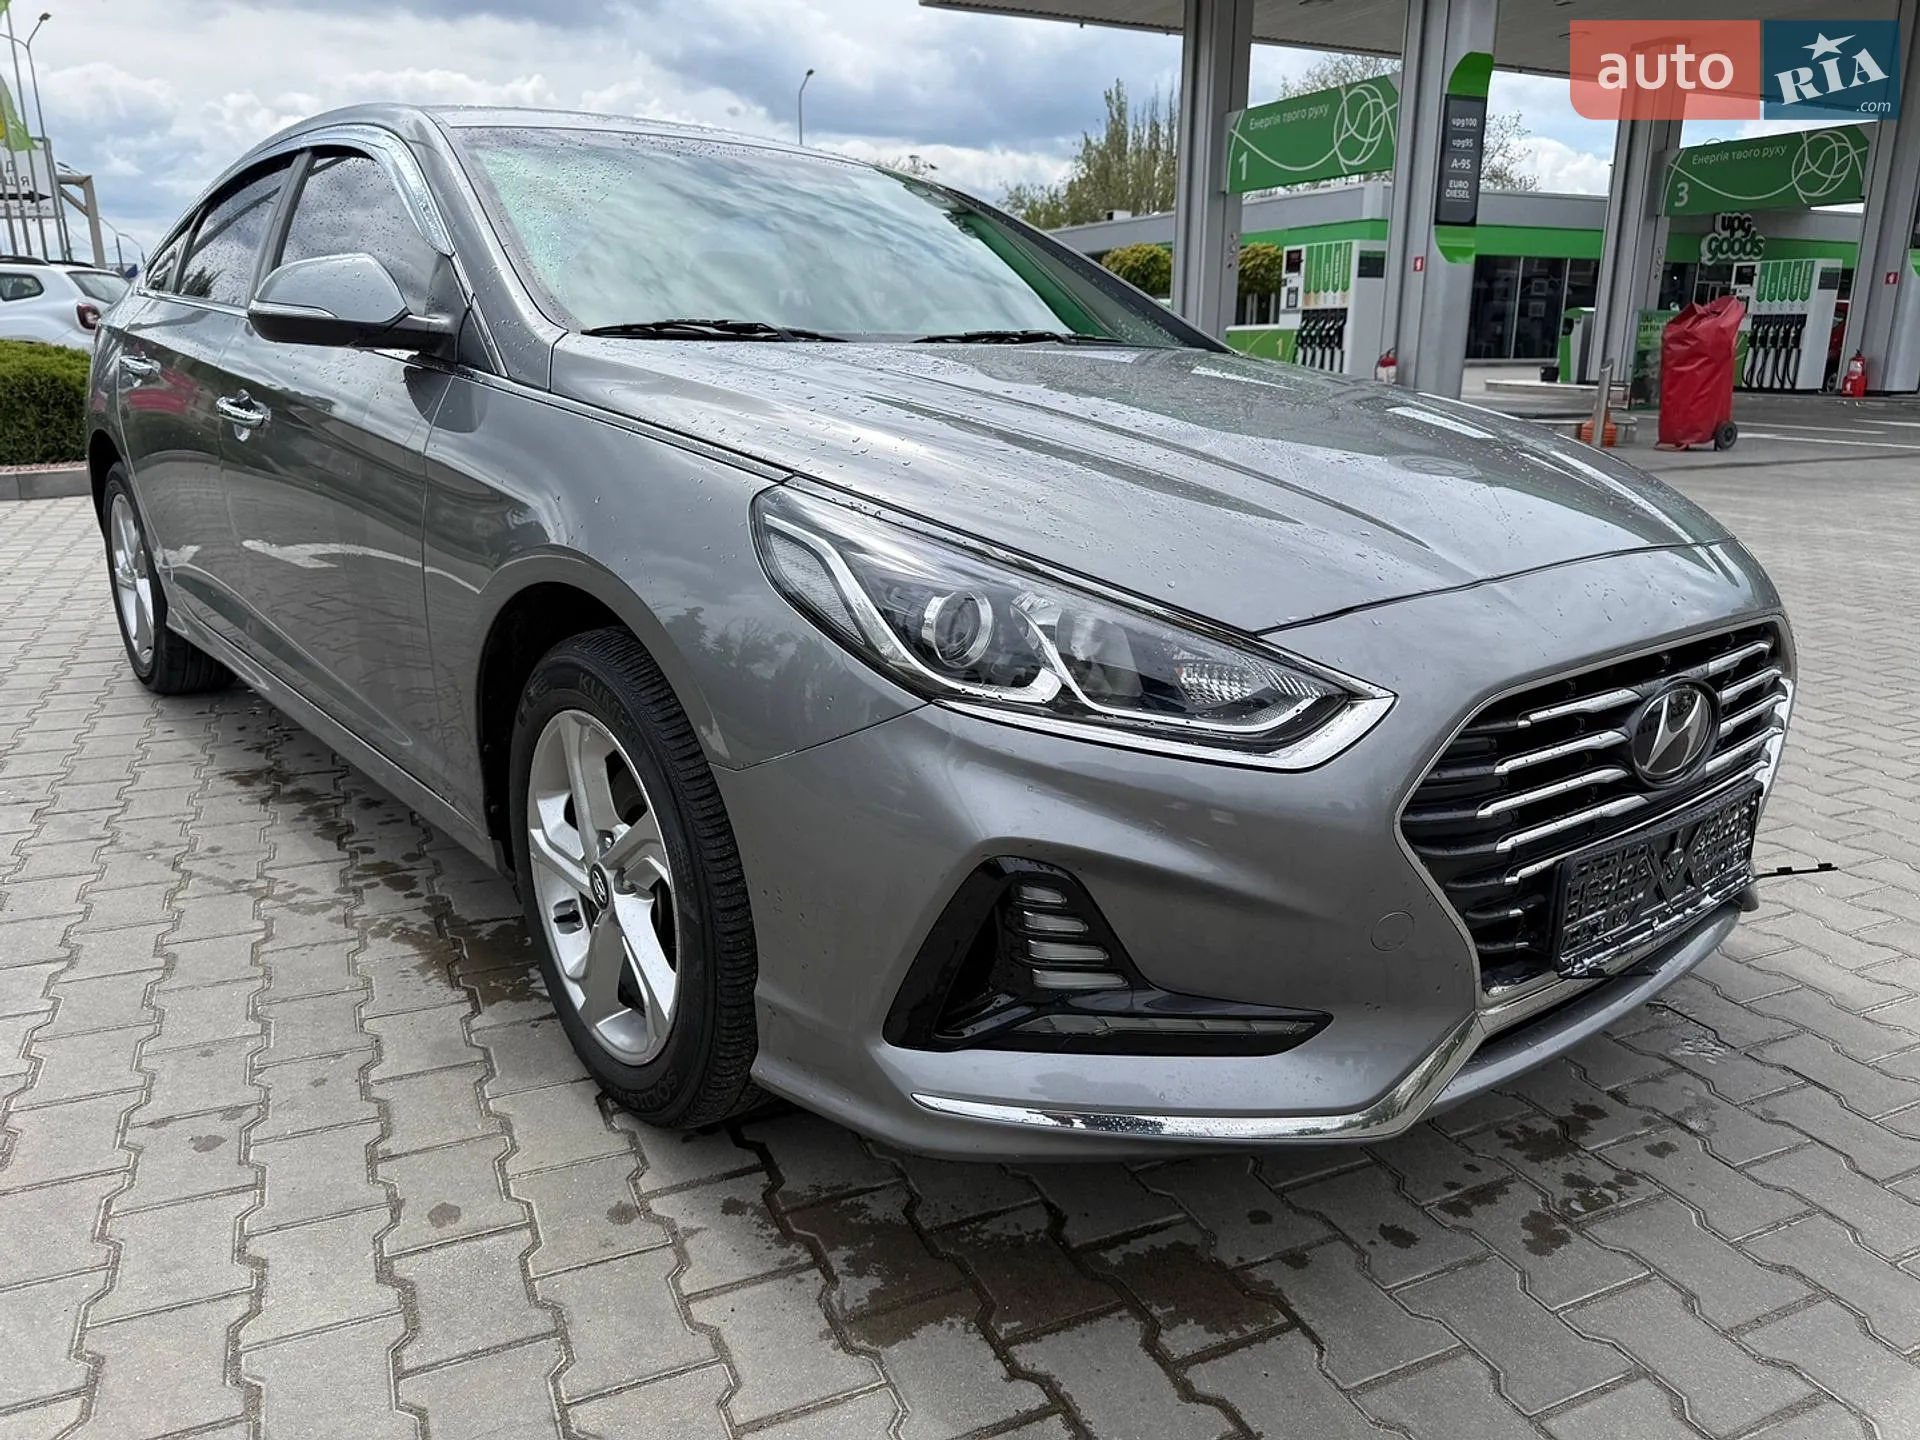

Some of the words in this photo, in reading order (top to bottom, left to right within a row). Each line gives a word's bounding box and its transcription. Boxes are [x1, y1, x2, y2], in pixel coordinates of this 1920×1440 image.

[1283, 109, 1307, 123] твого
[1307, 104, 1330, 120] руху
[1731, 148, 1760, 160] твого
[1761, 144, 1788, 158] руху
[1238, 151, 1248, 181] 1
[1445, 189, 1470, 199] DIESEL
[1448, 180, 1469, 189] EURO
[1674, 181, 1690, 207] 3
[1276, 338, 1284, 357] 1
